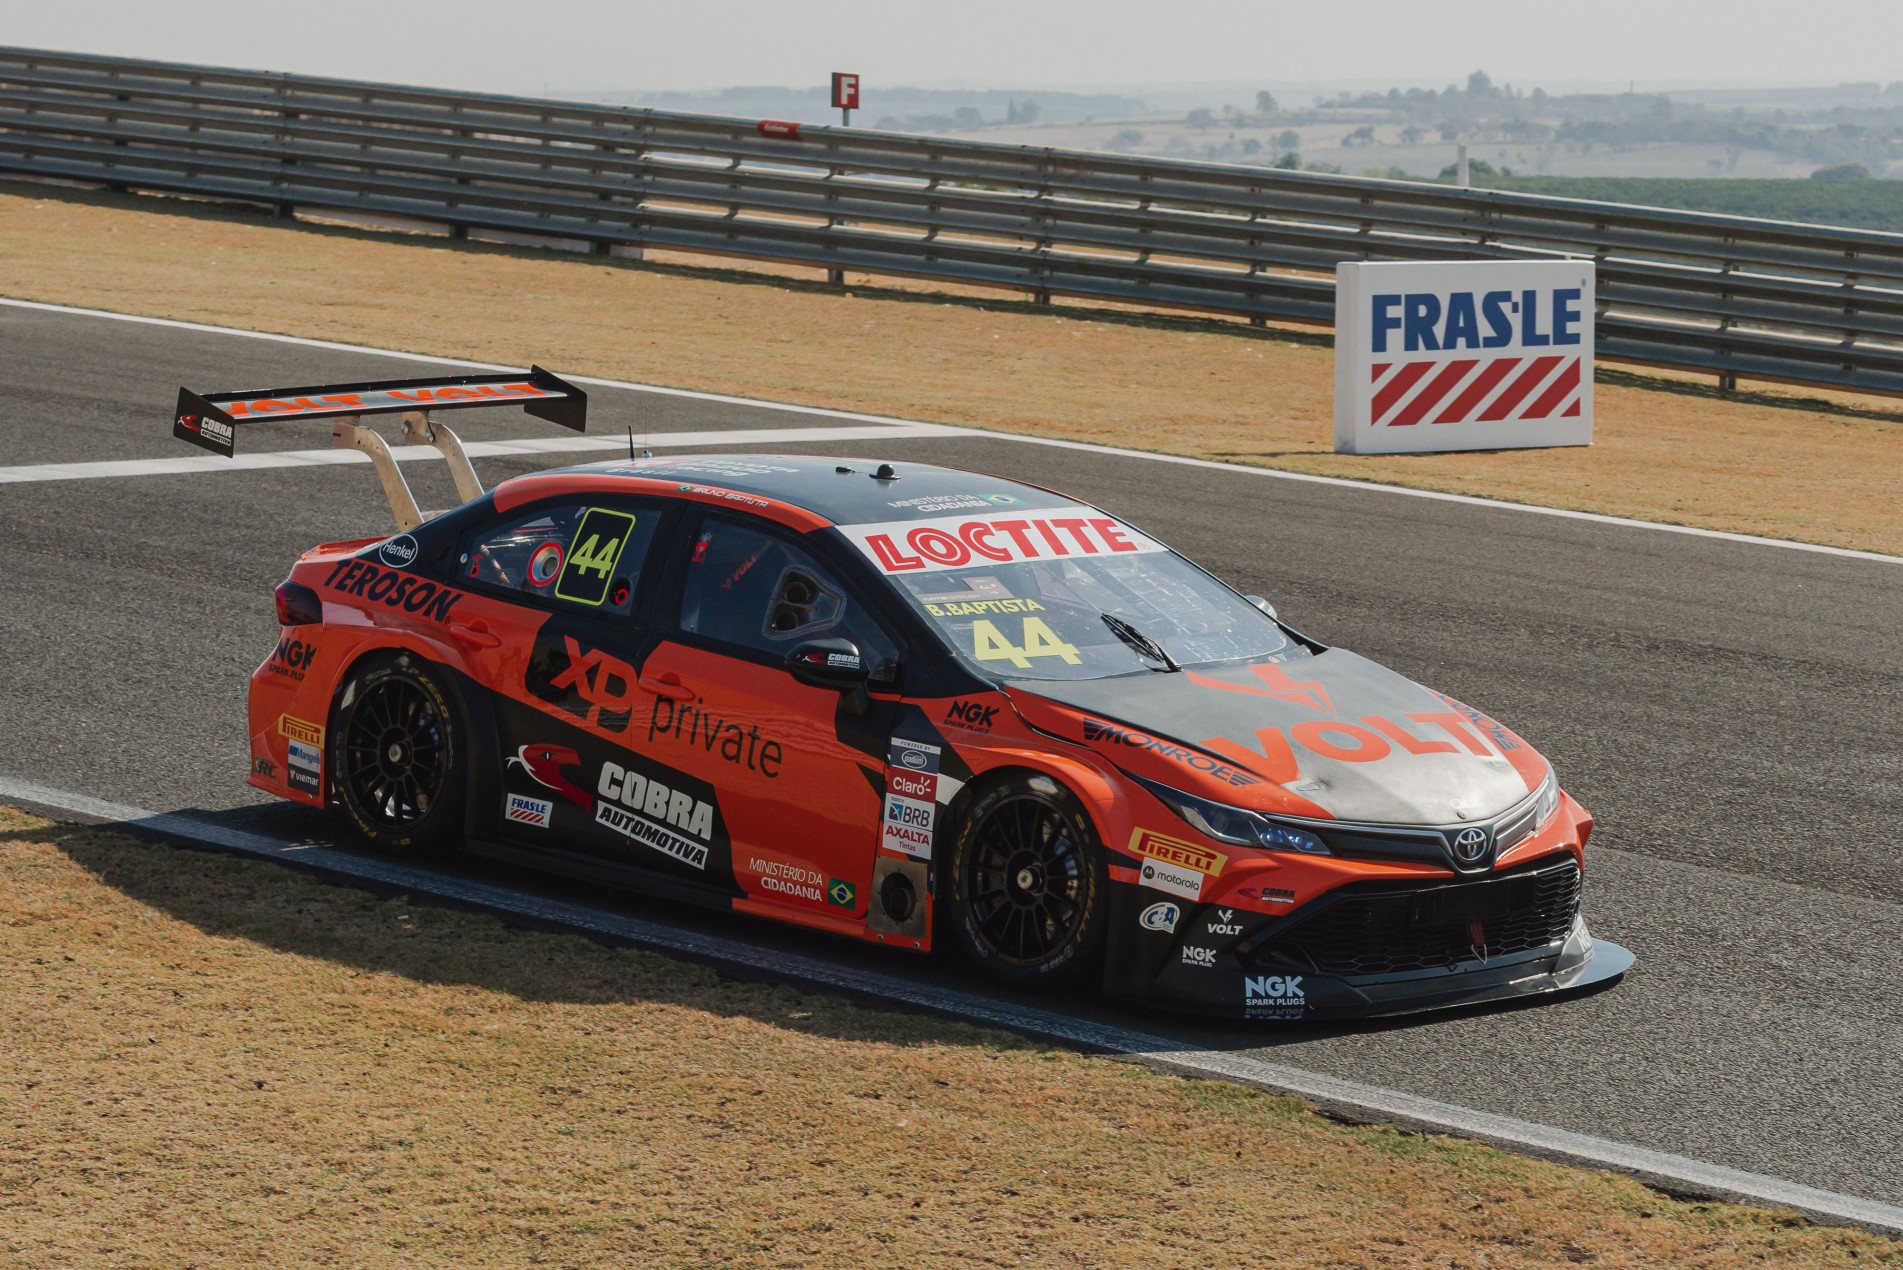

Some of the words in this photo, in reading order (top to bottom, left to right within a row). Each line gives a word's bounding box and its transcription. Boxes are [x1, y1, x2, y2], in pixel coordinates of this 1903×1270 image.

[841, 76, 856, 105] F
[221, 393, 368, 417] VOLT
[386, 383, 549, 404] VOLT
[201, 416, 233, 439] COBRA
[692, 487, 725, 497] BRUNO
[382, 541, 415, 560] Henkel
[569, 534, 620, 579] 44
[865, 518, 1139, 572] LOCTITE
[323, 559, 464, 622] TEROSON
[925, 598, 1047, 617] B.BAPTISTA
[272, 637, 318, 671] NGK
[973, 616, 1083, 669] 44
[268, 663, 290, 677] SPARK
[828, 653, 860, 663] COBRA
[550, 635, 637, 722] XP
[947, 700, 1000, 727] NGK
[282, 716, 321, 745] PIRELLI
[648, 692, 783, 779] private
[1094, 725, 1233, 782] MONROE
[1198, 711, 1498, 785] VOLT
[892, 777, 925, 795] Claro
[598, 761, 714, 841] COBRA
[903, 806, 931, 827] BRB
[599, 807, 707, 868] AUTOMOTIVA
[885, 825, 930, 846] AXALTA
[899, 841, 916, 852] Tintas
[1138, 832, 1218, 871] PIRELLI
[749, 857, 806, 882] MINISTÉRIO
[807, 871, 823, 887] DA
[1157, 871, 1200, 891] motorola
[761, 876, 823, 902] CIDADANIA
[1261, 887, 1296, 898] COBRA
[1207, 923, 1244, 935] VOLT
[1182, 945, 1217, 963] NGK
[1245, 975, 1305, 997] NGK
[1246, 998, 1275, 1006] SPARK
[1276, 998, 1305, 1006] PLUGS
